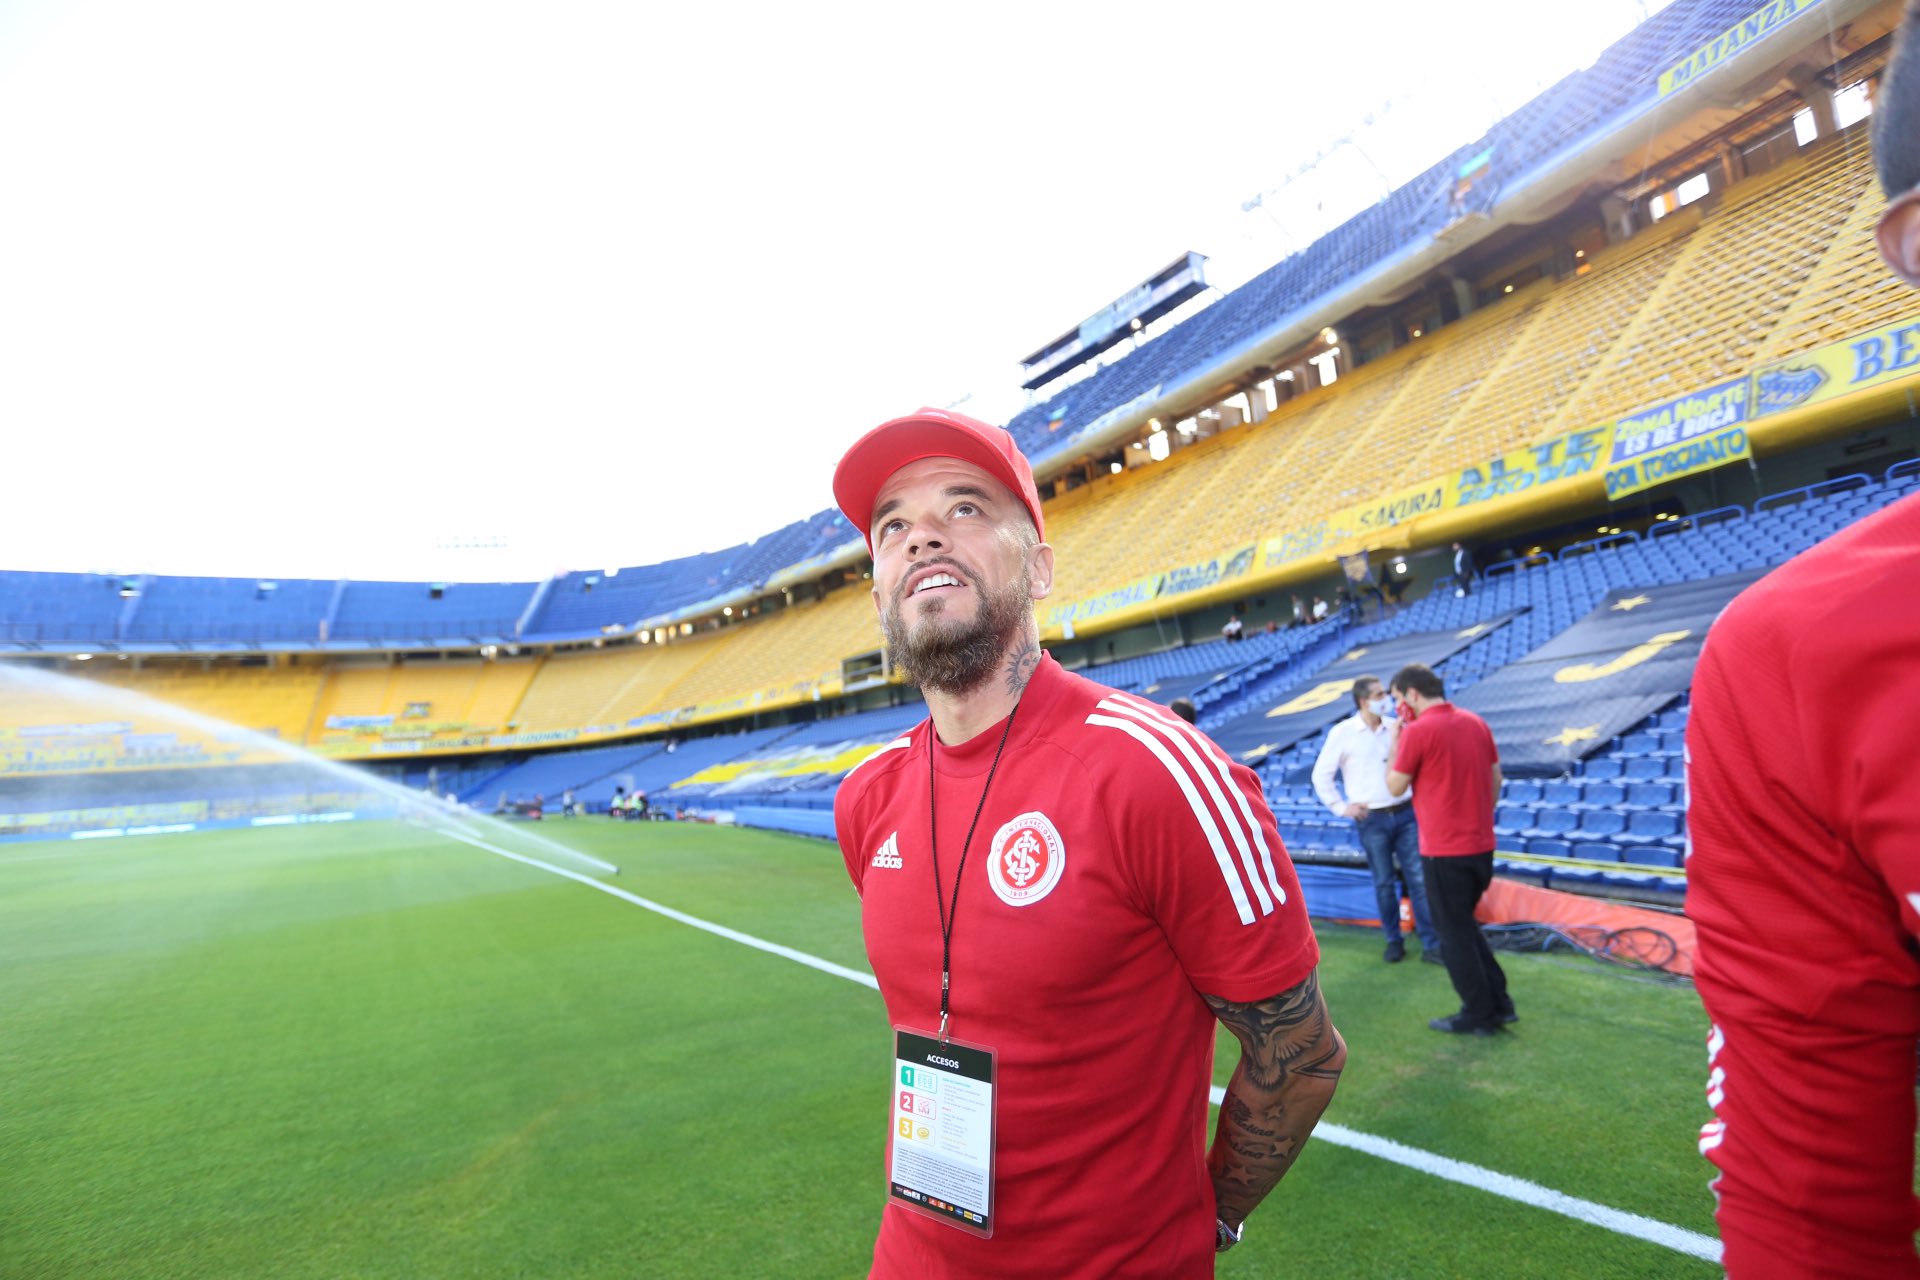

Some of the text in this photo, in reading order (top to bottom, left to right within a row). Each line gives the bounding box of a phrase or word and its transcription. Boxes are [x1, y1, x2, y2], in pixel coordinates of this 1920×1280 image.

[871, 854, 903, 869] adidas
[926, 1053, 960, 1069] ACCESOS
[902, 1095, 911, 1110] 2
[901, 1119, 910, 1135] 3
